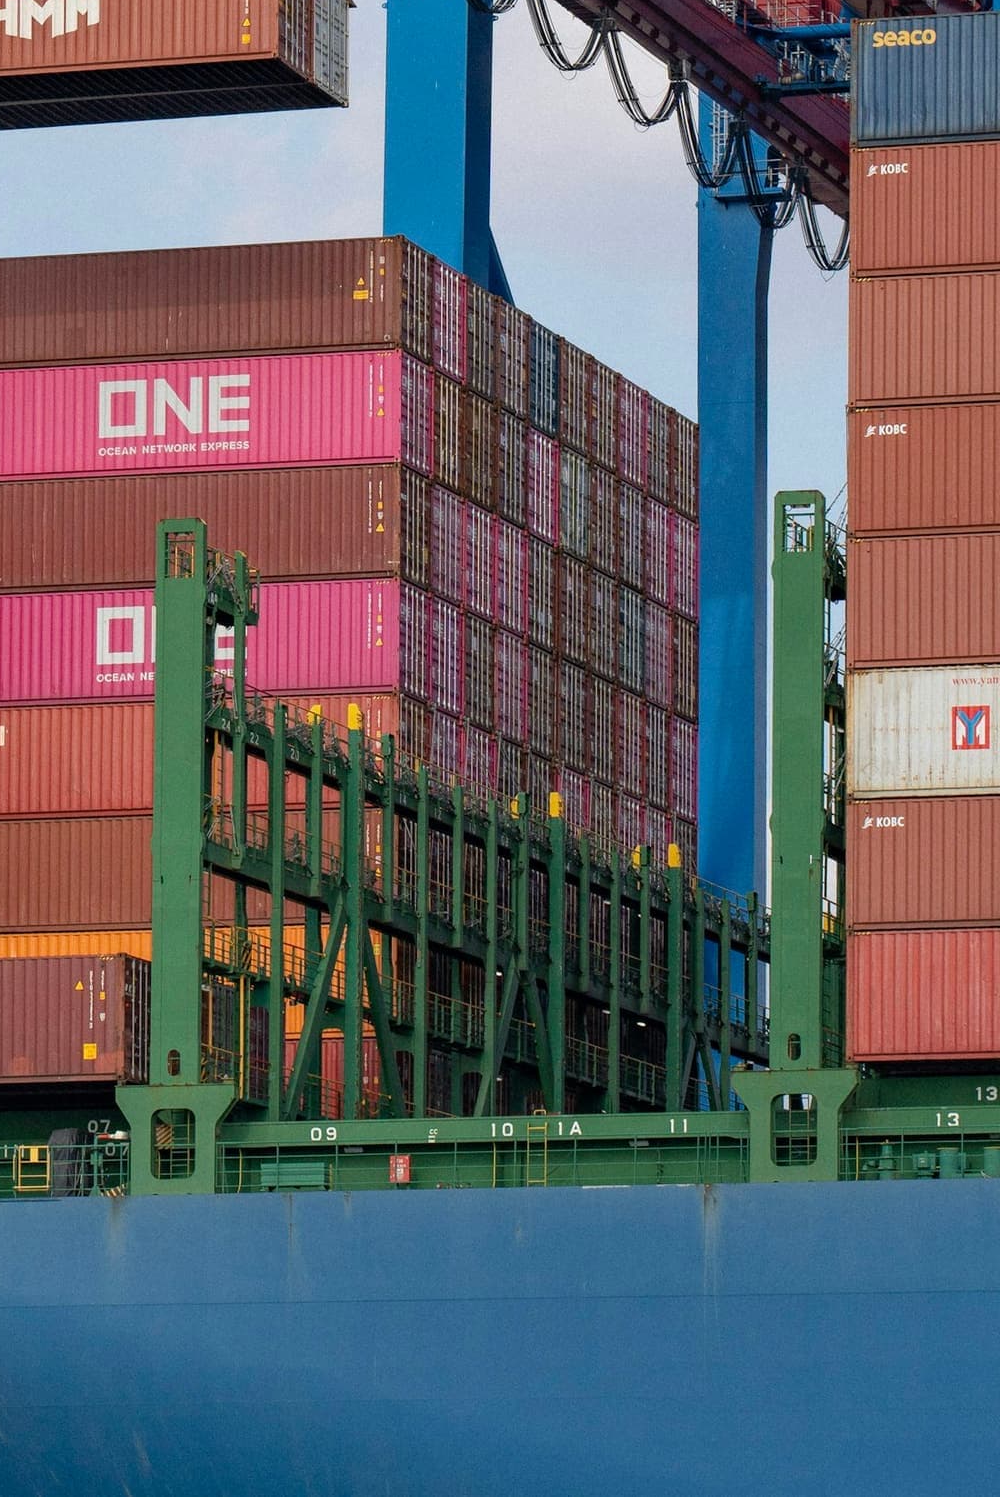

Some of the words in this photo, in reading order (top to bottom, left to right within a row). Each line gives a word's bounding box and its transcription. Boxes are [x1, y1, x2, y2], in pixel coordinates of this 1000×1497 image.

[872, 28, 936, 48] seaco
[881, 163, 908, 174] KOBC
[98, 374, 250, 437] ONE
[879, 423, 907, 436] KOBC
[98, 447, 137, 457] OCEAN
[142, 444, 197, 454] NETWORK
[200, 440, 250, 451] EXPRESS
[96, 605, 248, 663] OE
[96, 672, 135, 683] OCEAN
[222, 718, 231, 731] 24
[876, 816, 905, 828] KOBC
[975, 1086, 998, 1101] 13
[88, 1120, 111, 1133] 07
[670, 1118, 687, 1134] 11
[936, 1112, 960, 1127] 13
[310, 1126, 338, 1141] 09
[491, 1122, 514, 1137] 10
[558, 1121, 582, 1136] 1A
[105, 1142, 129, 1156] 07
